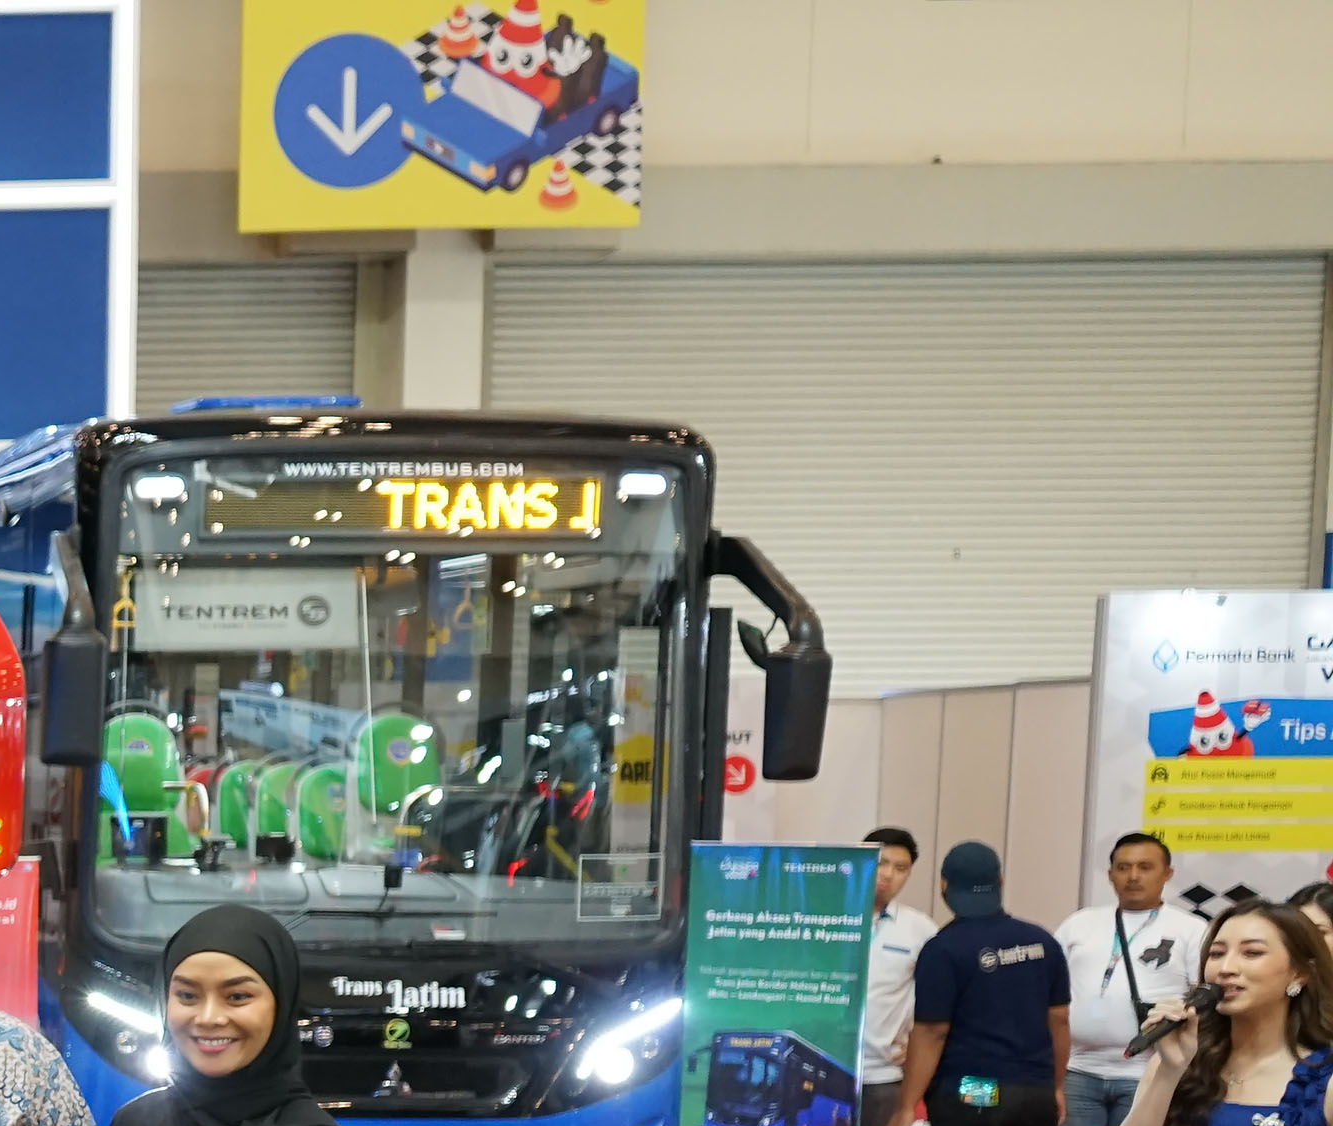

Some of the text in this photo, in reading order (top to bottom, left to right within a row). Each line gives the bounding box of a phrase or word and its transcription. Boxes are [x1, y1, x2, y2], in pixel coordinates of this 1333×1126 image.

[284, 462, 524, 477] WWW.TENTREMBUS.COM
[377, 480, 559, 530] TRANS
[162, 604, 289, 620] TENTREM
[1257, 648, 1296, 664] Bank
[1281, 719, 1326, 744] Tips
[705, 909, 863, 927] Gerbang Akses Transportasi
[706, 926, 736, 940] Jatim
[738, 929, 766, 941] yang
[768, 927, 801, 941] Andal
[815, 929, 862, 943] Nyaman
[330, 976, 467, 1014] Trans Jatim
